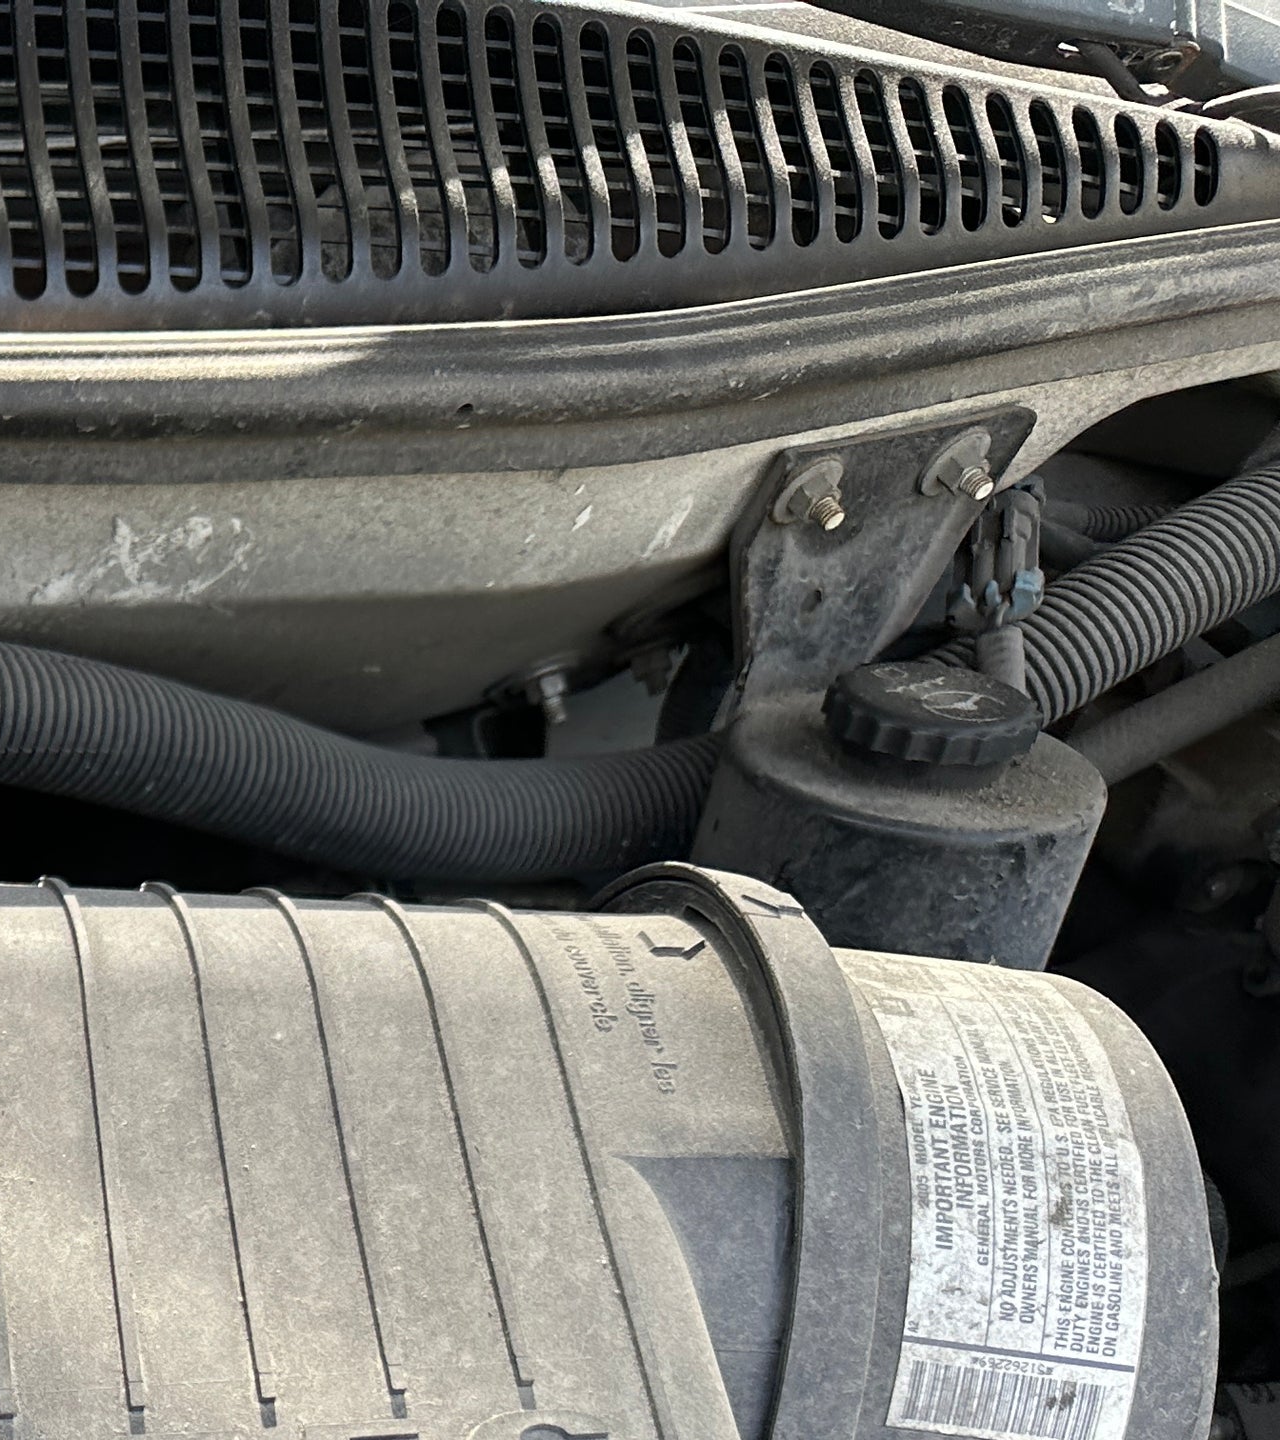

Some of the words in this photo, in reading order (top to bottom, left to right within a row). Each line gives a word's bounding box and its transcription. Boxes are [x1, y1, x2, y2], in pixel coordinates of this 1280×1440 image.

[981, 1067, 1006, 1109] SERVICE
[1021, 1038, 1058, 1104] REGULATIONS
[918, 1069, 946, 1129] ENGINE
[953, 1055, 983, 1134] CORPORATION
[1052, 1081, 1073, 1102] USE
[1073, 1090, 1090, 1114] FUEL
[994, 1111, 1012, 1133] SEE
[1046, 1108, 1063, 1127] EPA
[1060, 1106, 1078, 1128] FOR
[1086, 1084, 1118, 1149] APPLICABLE
[910, 1119, 927, 1165] MODEL
[942, 1085, 974, 1209] INFORMATION
[1018, 1135, 1034, 1172] MORE
[1080, 1119, 1101, 1154] CLEAN
[972, 1140, 989, 1196] MOTORS
[1058, 1162, 1070, 1178] TO
[1070, 1131, 1088, 1194] CERTIFIED
[1089, 1158, 1102, 1182] THE
[1105, 1154, 1118, 1177] ALL
[931, 1134, 953, 1250] IMPORTANT
[1022, 1175, 1037, 1200] FOR
[1075, 1199, 1089, 1212] IS
[1091, 1188, 1104, 1204] TO
[1106, 1182, 1122, 1225] MEETS
[977, 1202, 990, 1266] GENERAL
[1001, 1199, 1018, 1298] ADJUSTMENTS
[1023, 1205, 1038, 1261] MANUAL
[1077, 1216, 1090, 1244] AND
[1092, 1210, 1106, 1279] CERTIFIED
[1109, 1230, 1122, 1258] AND
[1058, 1262, 1075, 1312] ENGINE
[1076, 1250, 1090, 1308] ENGINES
[1092, 1284, 1106, 1297] IS
[1106, 1263, 1123, 1330] GASOLINE
[998, 1302, 1016, 1322] NO
[1086, 1302, 1104, 1354] ENGINE
[1054, 1318, 1070, 1350] THIS
[1070, 1314, 1086, 1352] DUTY
[1102, 1337, 1116, 1357] ON
